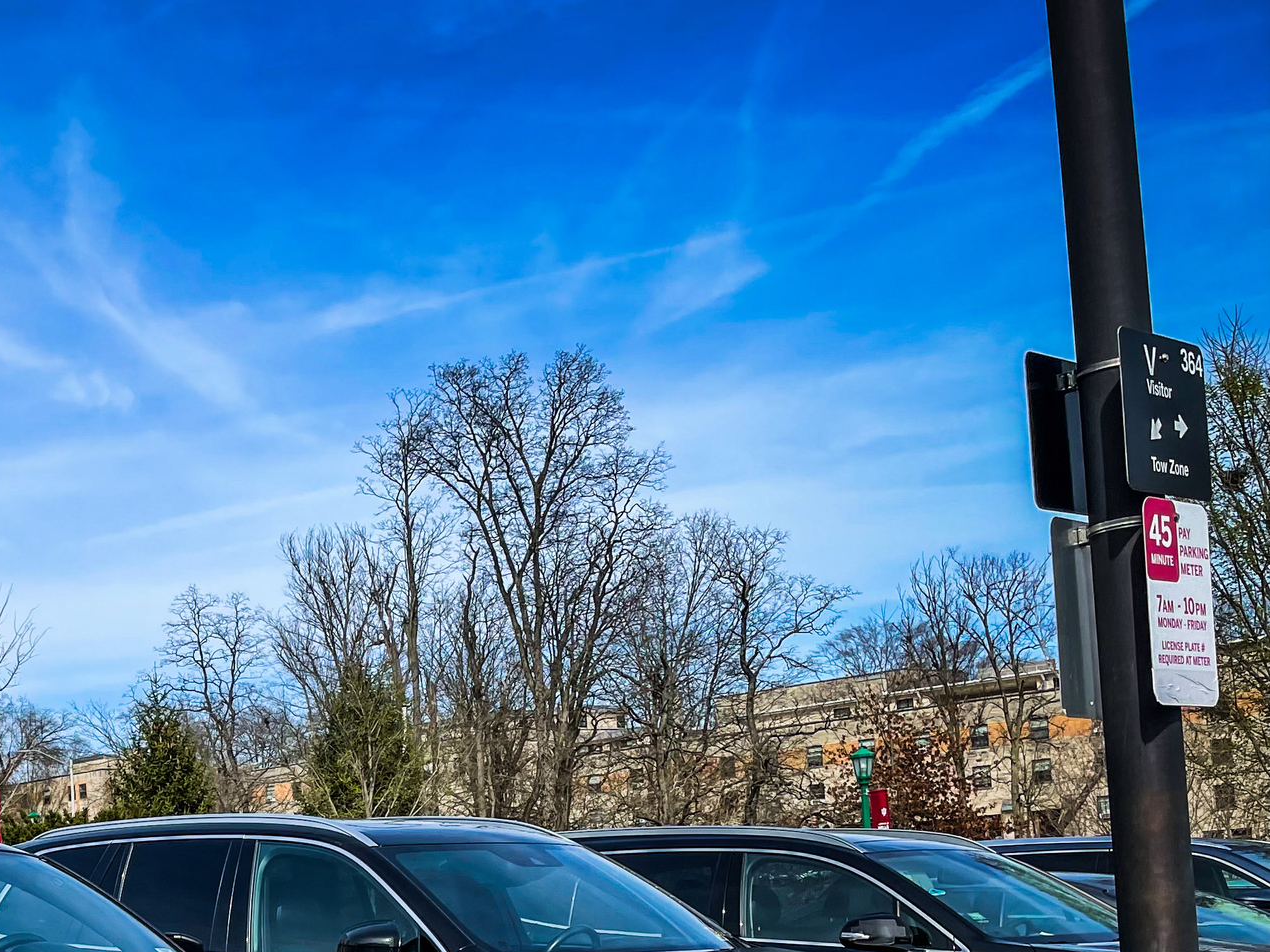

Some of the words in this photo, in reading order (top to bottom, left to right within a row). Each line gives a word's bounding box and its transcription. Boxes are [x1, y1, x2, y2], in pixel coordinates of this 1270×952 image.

[1143, 344, 1156, 376] V
[1180, 348, 1203, 378] 364
[1146, 378, 1173, 399] Visitor
[1150, 455, 1168, 473] Tow
[1168, 458, 1190, 477] Zone
[1149, 513, 1173, 548] 45
[1178, 527, 1191, 540] PAY
[1150, 552, 1175, 567] MINUTE
[1179, 545, 1209, 560] PARKING
[1180, 563, 1204, 577] METER
[1156, 594, 1175, 613] 7AM
[1183, 597, 1207, 616] 10PM
[1157, 617, 1183, 629] MONDAY
[1187, 619, 1208, 631] FRIDAY
[1161, 641, 1184, 651] LICENSE
[1184, 642, 1200, 652] PLATE
[1158, 654, 1185, 666] REQUIRED
[1185, 656, 1192, 665] AT
[1192, 656, 1211, 666] METER
